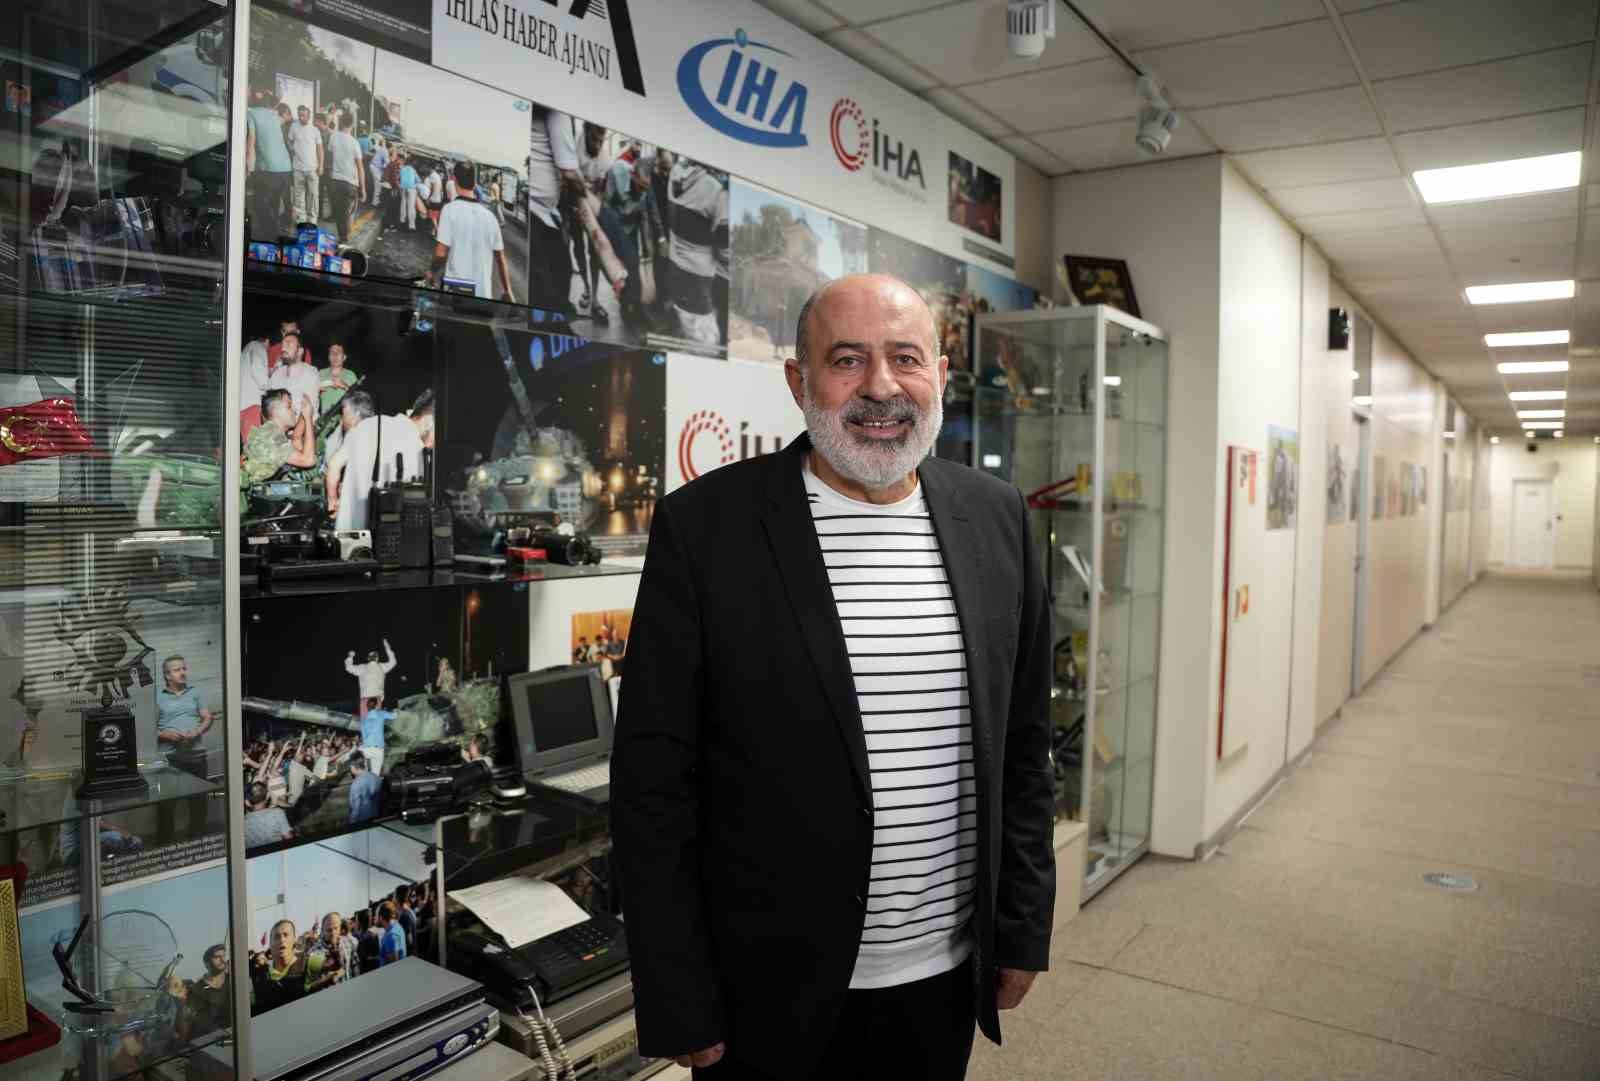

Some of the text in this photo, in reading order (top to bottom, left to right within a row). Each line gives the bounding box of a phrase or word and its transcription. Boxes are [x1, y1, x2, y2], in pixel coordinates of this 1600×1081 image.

[503, 4, 559, 60] HABER
[561, 31, 611, 80] AJANSI
[871, 118, 926, 190] İHA
